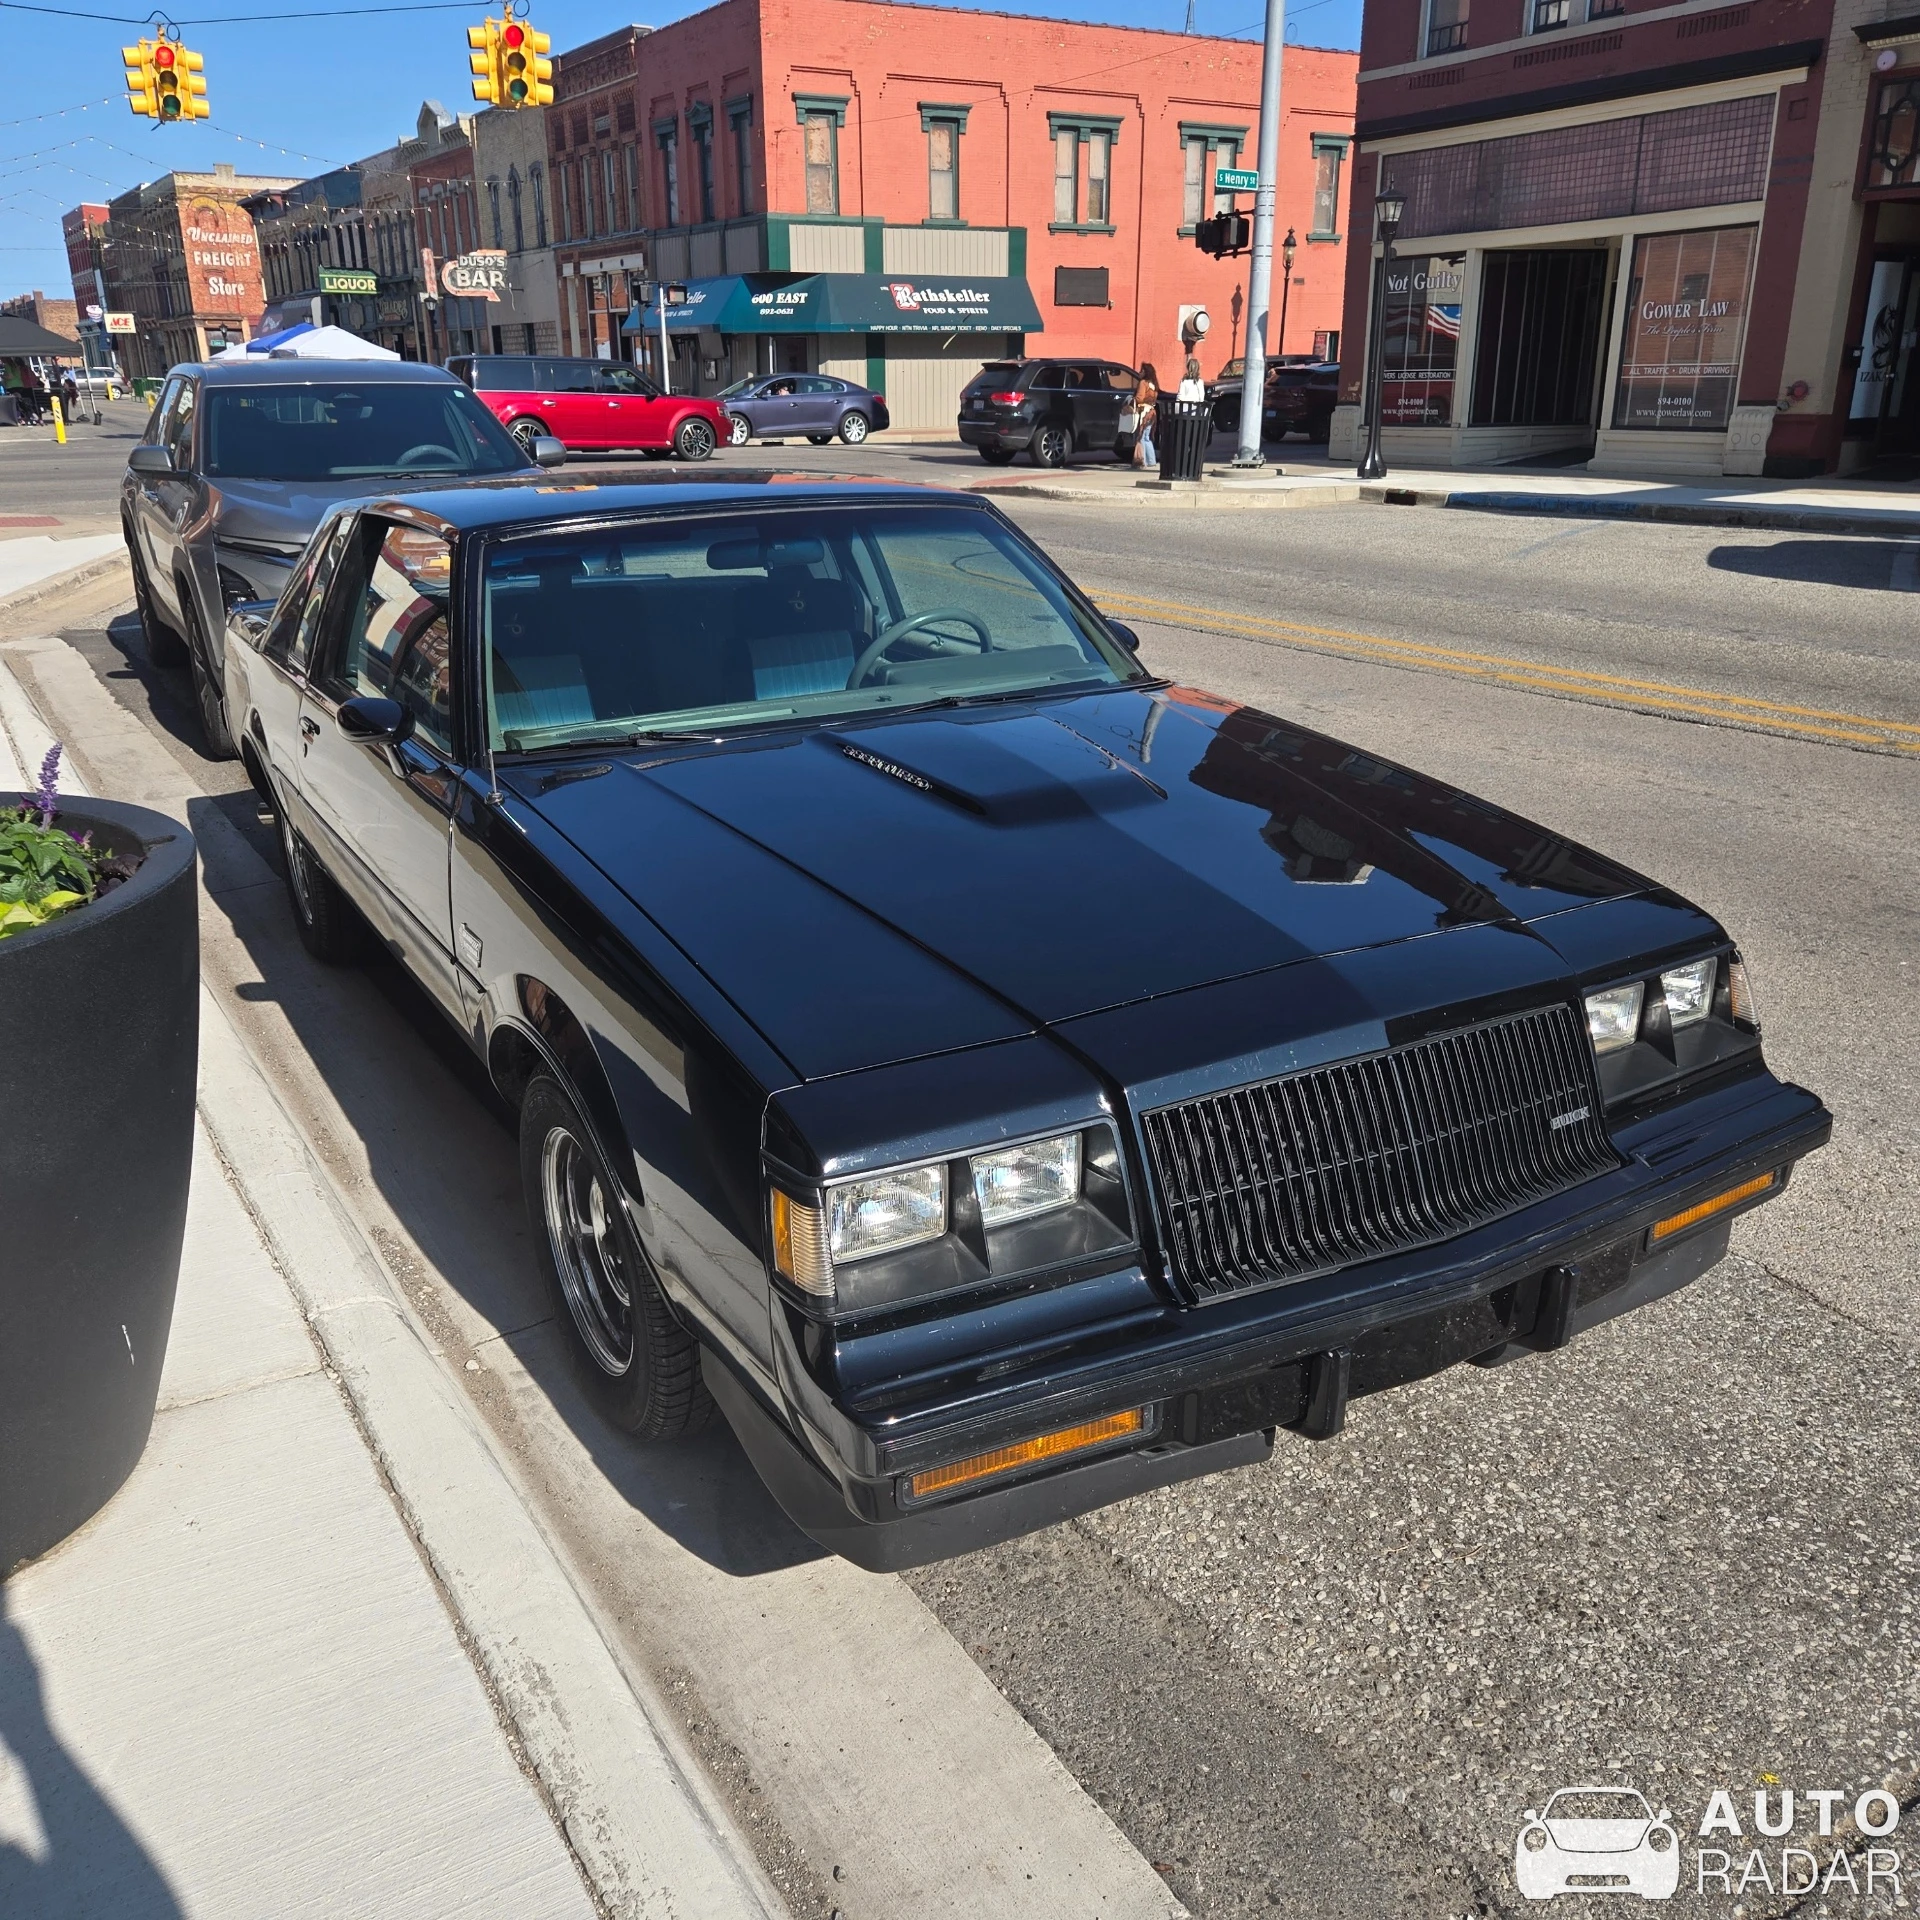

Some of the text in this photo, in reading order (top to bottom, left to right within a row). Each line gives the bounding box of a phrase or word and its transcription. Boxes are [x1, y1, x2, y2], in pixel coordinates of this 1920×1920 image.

[1224, 173, 1249, 188] Henry
[186, 227, 253, 244] UNCLAIMED
[193, 250, 252, 267] FREIGHT
[459, 255, 505, 267] DUSO'S
[208, 276, 246, 295] Store
[325, 277, 377, 290] LIQUOR
[456, 269, 506, 288] BAR
[1388, 271, 1463, 292] Not Guilty
[751, 292, 808, 304] 600 EAST
[893, 286, 990, 307] Rathskeller
[110, 317, 131, 327] ACE
[1641, 322, 1724, 342] The People's Firm
[1383, 371, 1451, 380] VERS LICENSE RESTORATION
[1629, 366, 1730, 375] ALL TRAFFIC DRUNK DRIVING
[1657, 397, 1692, 405] 894-0100
[1636, 407, 1712, 419] www.gowerlaw.com
[1550, 1105, 1591, 1131] BUICK
